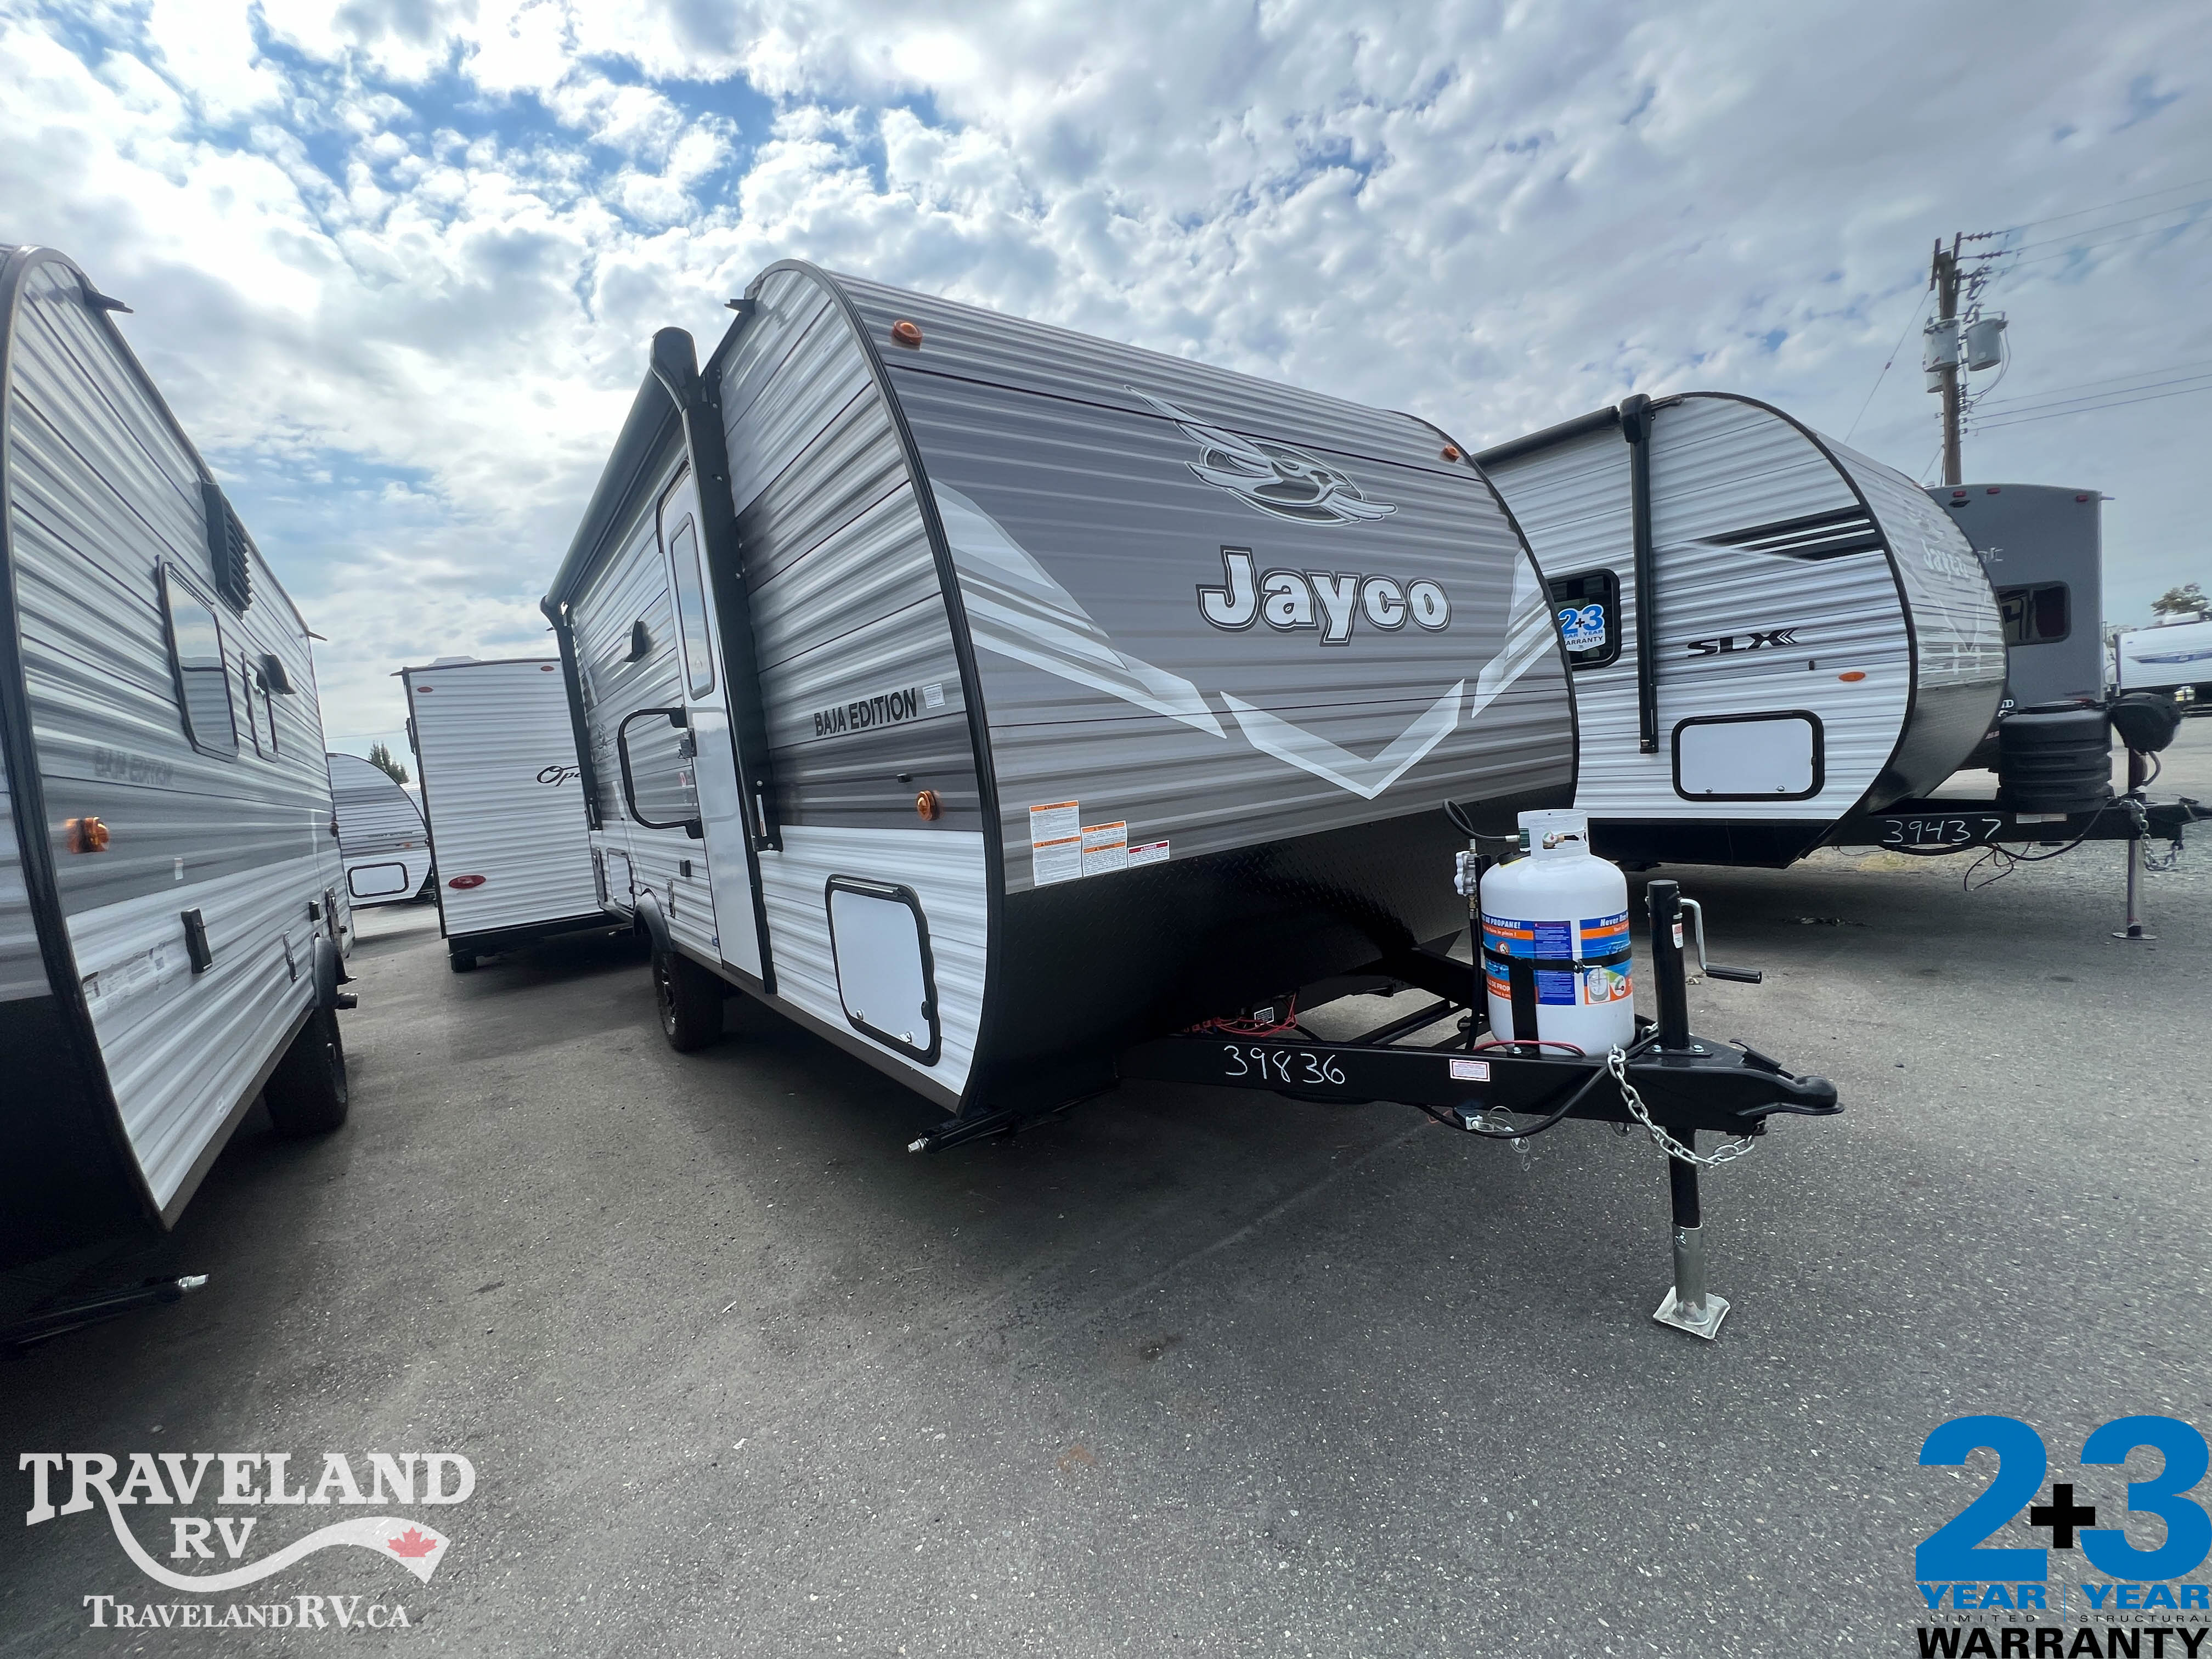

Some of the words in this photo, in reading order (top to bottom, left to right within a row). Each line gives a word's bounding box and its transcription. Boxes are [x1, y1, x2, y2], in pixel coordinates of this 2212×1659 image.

[1195, 545, 1452, 647] Jayco
[1559, 606, 1603, 634] 2+3
[1565, 636, 1603, 645] ARRANTY
[1688, 628, 1799, 657] SLX
[814, 707, 847, 736] BAJA
[849, 687, 917, 730] EDITION
[1883, 818, 2002, 843] 39437
[1491, 917, 1521, 929] PROPANE!
[1600, 917, 1619, 927] Never
[1497, 983, 1510, 992] PROP
[1224, 1045, 1345, 1084] 39836
